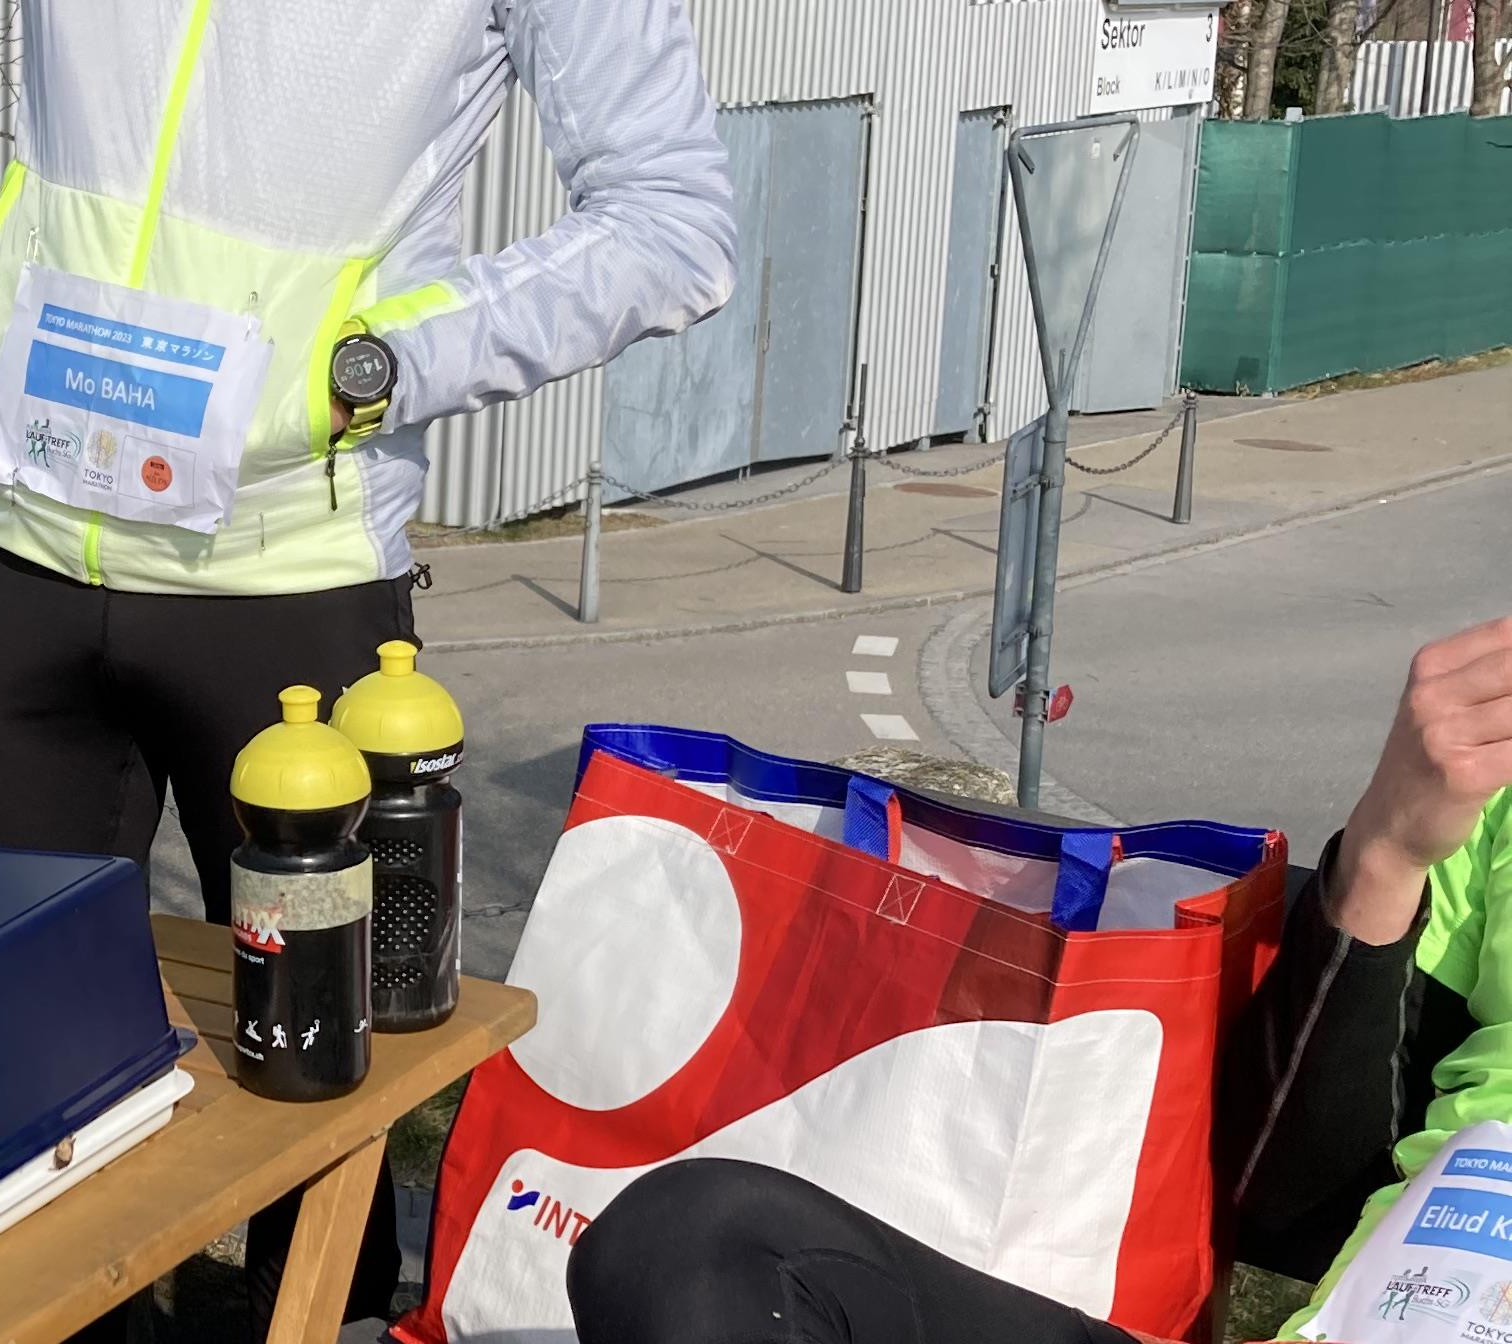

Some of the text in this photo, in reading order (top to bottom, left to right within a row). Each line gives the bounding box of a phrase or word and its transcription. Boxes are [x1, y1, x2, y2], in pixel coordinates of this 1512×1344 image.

[1101, 13, 1213, 50] Sektor 3
[1096, 75, 1121, 96] Block
[45, 312, 133, 344] TOKYO MARATHON 2023
[141, 336, 215, 361] 東京マラソン
[65, 367, 155, 411] Mo BAHA
[82, 479, 112, 491] MARATHON
[84, 468, 114, 485] TOKYO
[1454, 1157, 1488, 1169] TOKYO
[1420, 1204, 1490, 1234] Eliud
